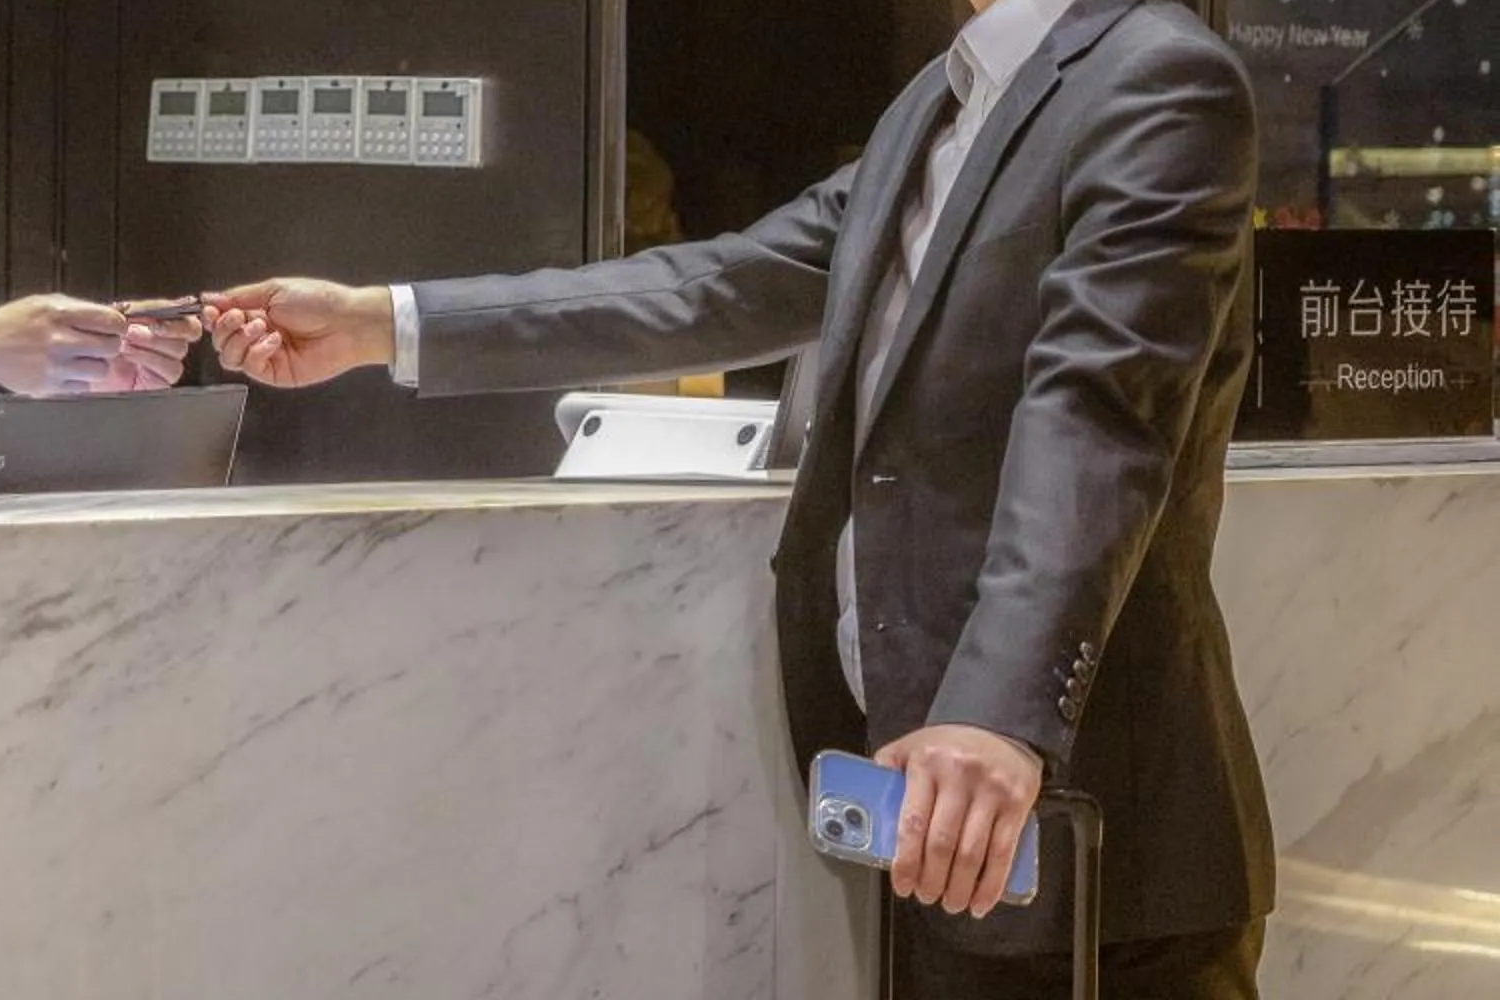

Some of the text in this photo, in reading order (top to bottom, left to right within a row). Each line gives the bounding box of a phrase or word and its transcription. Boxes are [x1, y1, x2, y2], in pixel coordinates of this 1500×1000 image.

[1229, 21, 1371, 50] Happy New Year
[1300, 279, 1477, 338] 前台接待
[1337, 362, 1444, 395] Reception
